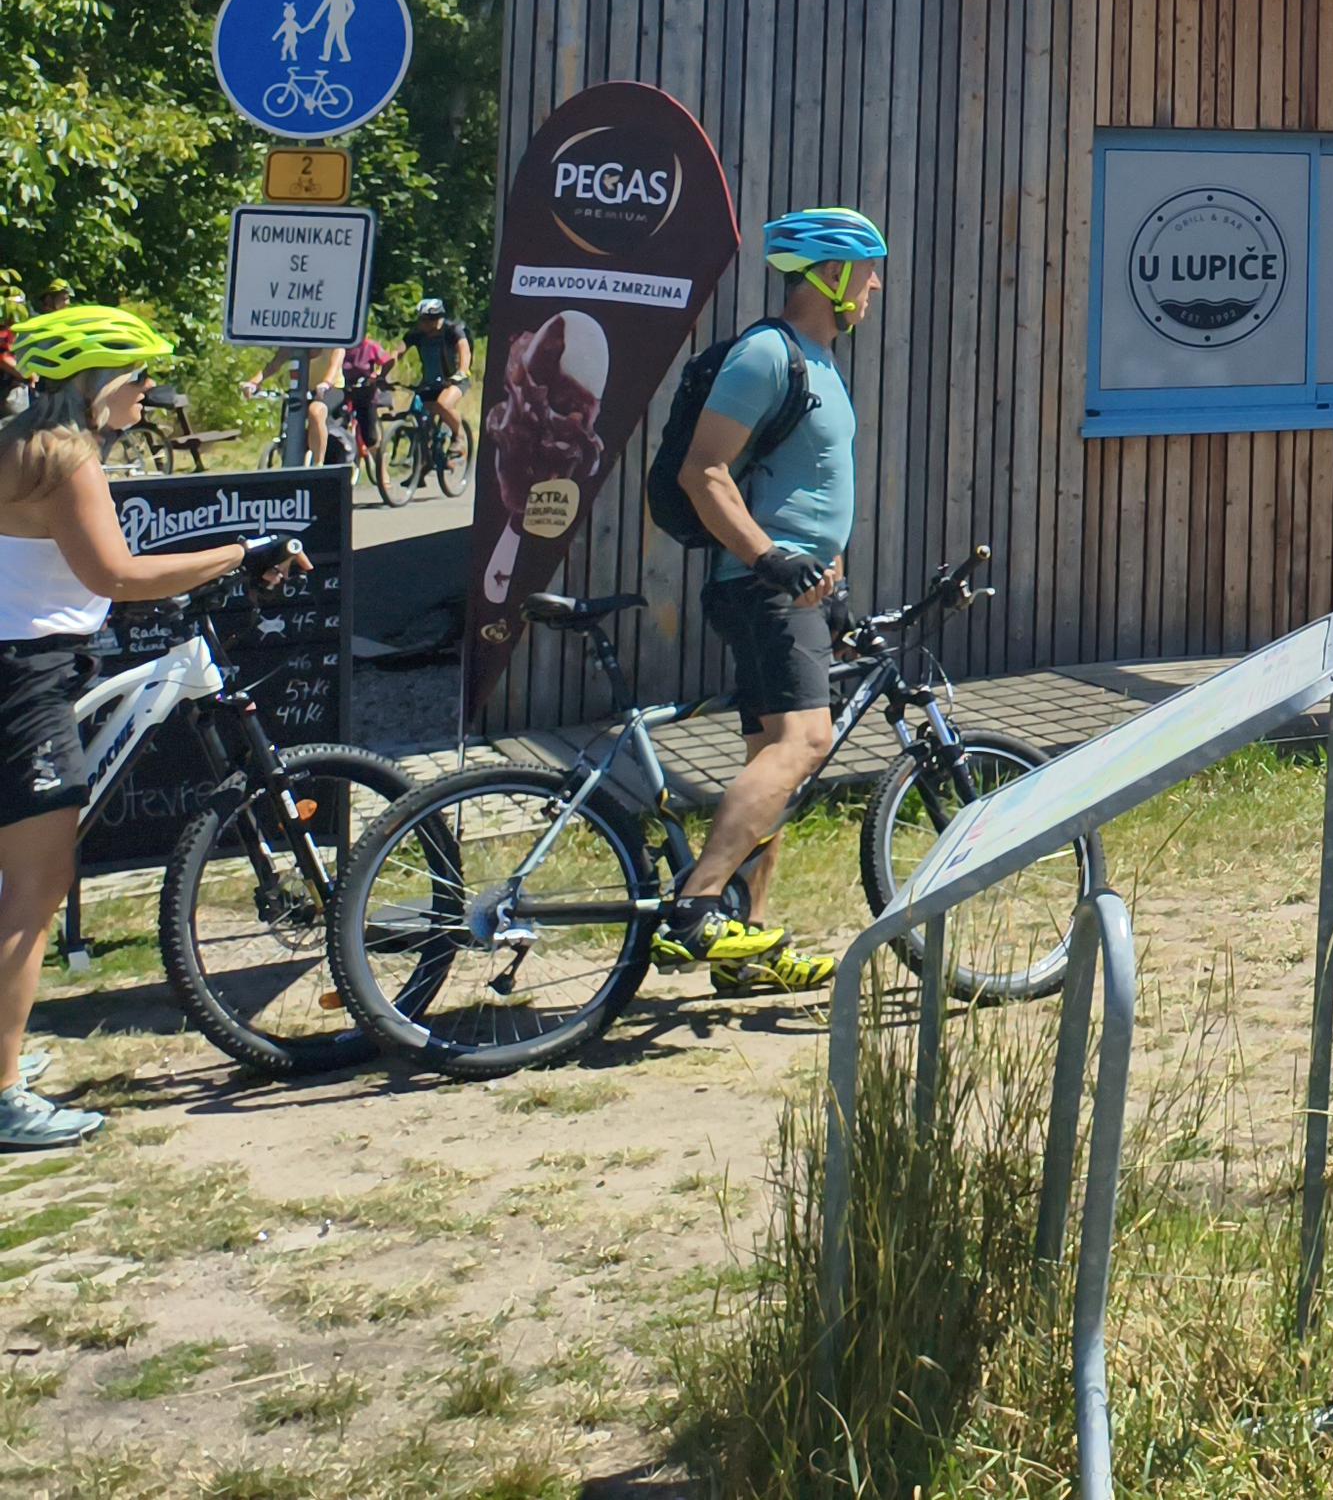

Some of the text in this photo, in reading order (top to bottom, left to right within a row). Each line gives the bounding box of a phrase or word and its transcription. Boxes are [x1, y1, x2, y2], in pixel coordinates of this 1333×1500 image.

[301, 156, 313, 175] 2
[554, 162, 668, 205] PEGAS
[574, 208, 648, 222] PREMIUM
[1174, 214, 1205, 232] GRILL
[1223, 216, 1243, 230] BAR
[251, 225, 353, 246] KOMUNIKACE
[290, 254, 309, 272] SE
[1139, 246, 1277, 282] U LUPIČE
[270, 280, 325, 301] V ZIMĚ
[519, 275, 682, 300] OPRAVDOVÁ ZMRZLINA
[251, 308, 338, 330] NEUDRŽUJE
[1210, 309, 1237, 324] 1992
[527, 491, 569, 504] EXTRA
[121, 489, 312, 556] Pilsner Urquell
[292, 611, 317, 631] 45
